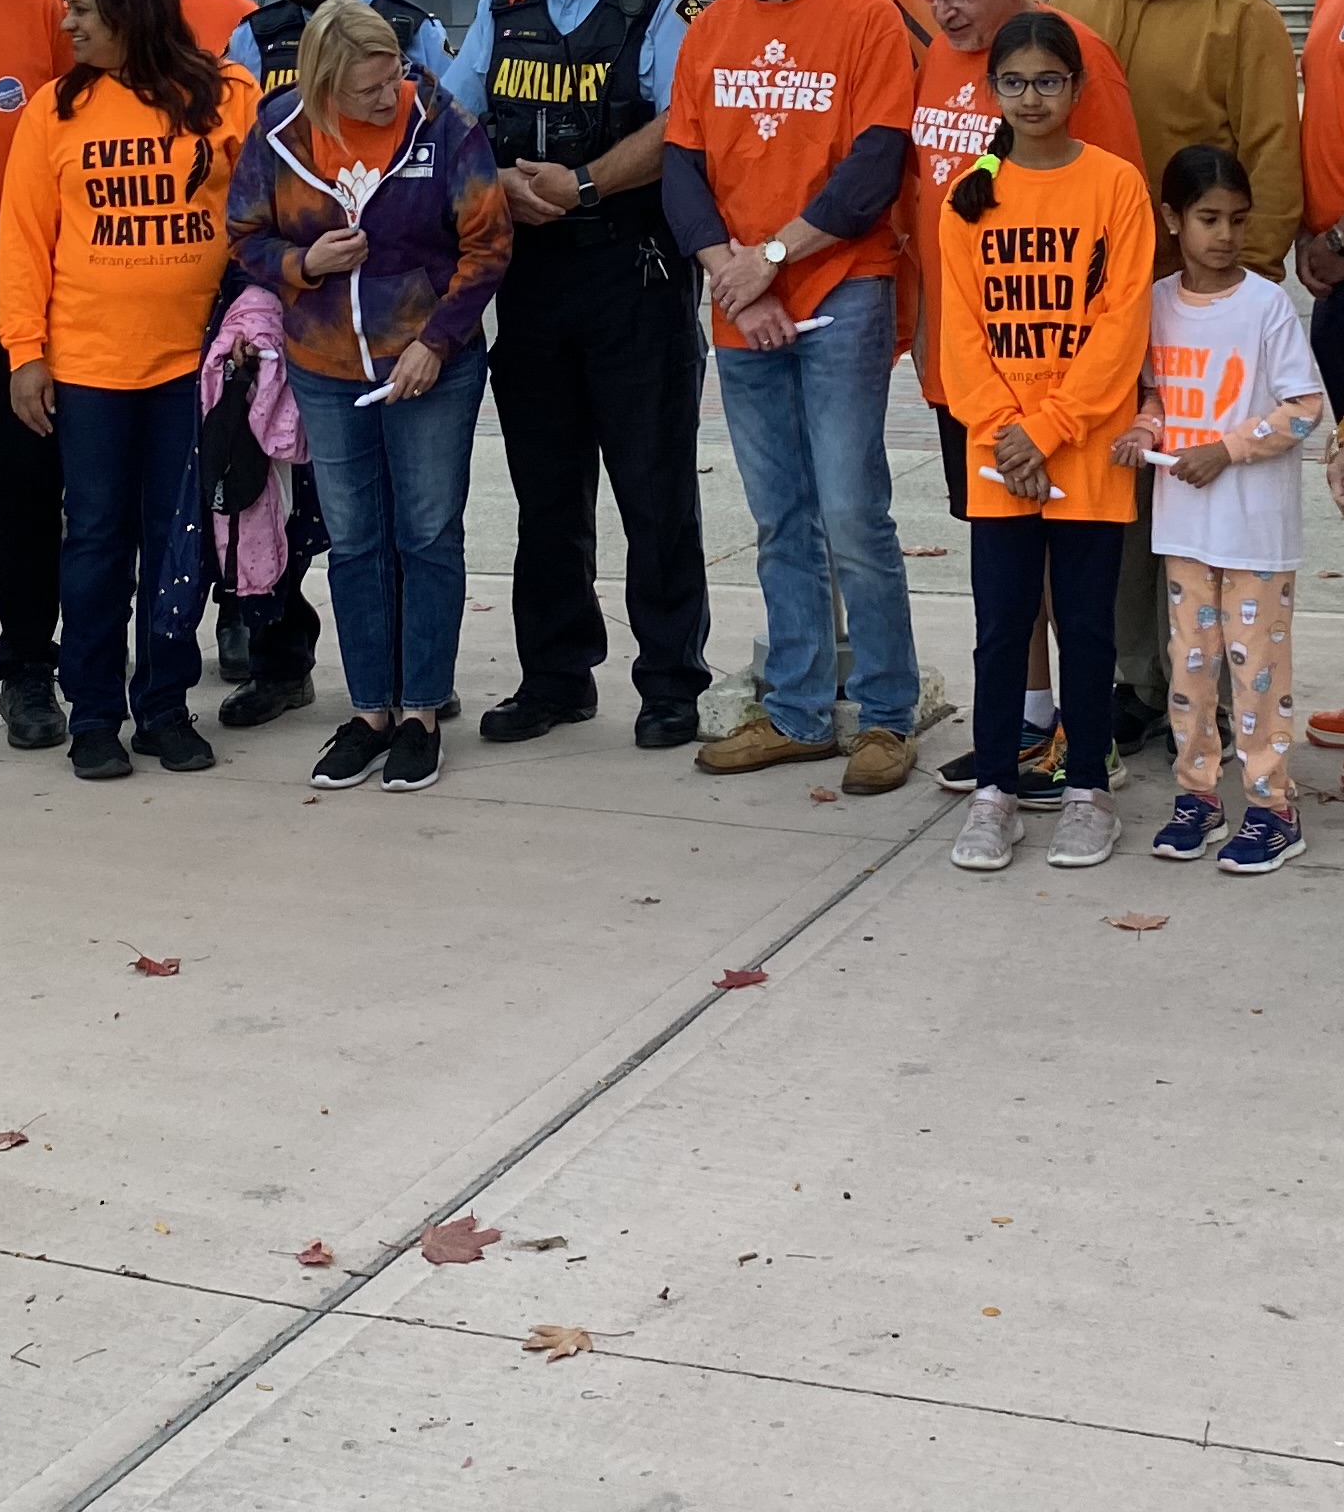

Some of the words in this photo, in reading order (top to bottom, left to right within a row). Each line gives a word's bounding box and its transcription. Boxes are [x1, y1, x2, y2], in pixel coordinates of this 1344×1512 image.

[493, 58, 611, 102] AUXILIARY
[713, 68, 772, 87] EVERY
[775, 70, 837, 88] CHILD
[714, 84, 834, 112] MATTERS
[83, 136, 175, 169] EVERY
[86, 174, 175, 208] CHILD
[91, 209, 215, 246] MATTERS
[89, 253, 202, 268] #orangeshirtday
[981, 227, 1080, 265] EVERY
[984, 274, 1074, 312] CHILD
[987, 322, 1092, 358] MATTER
